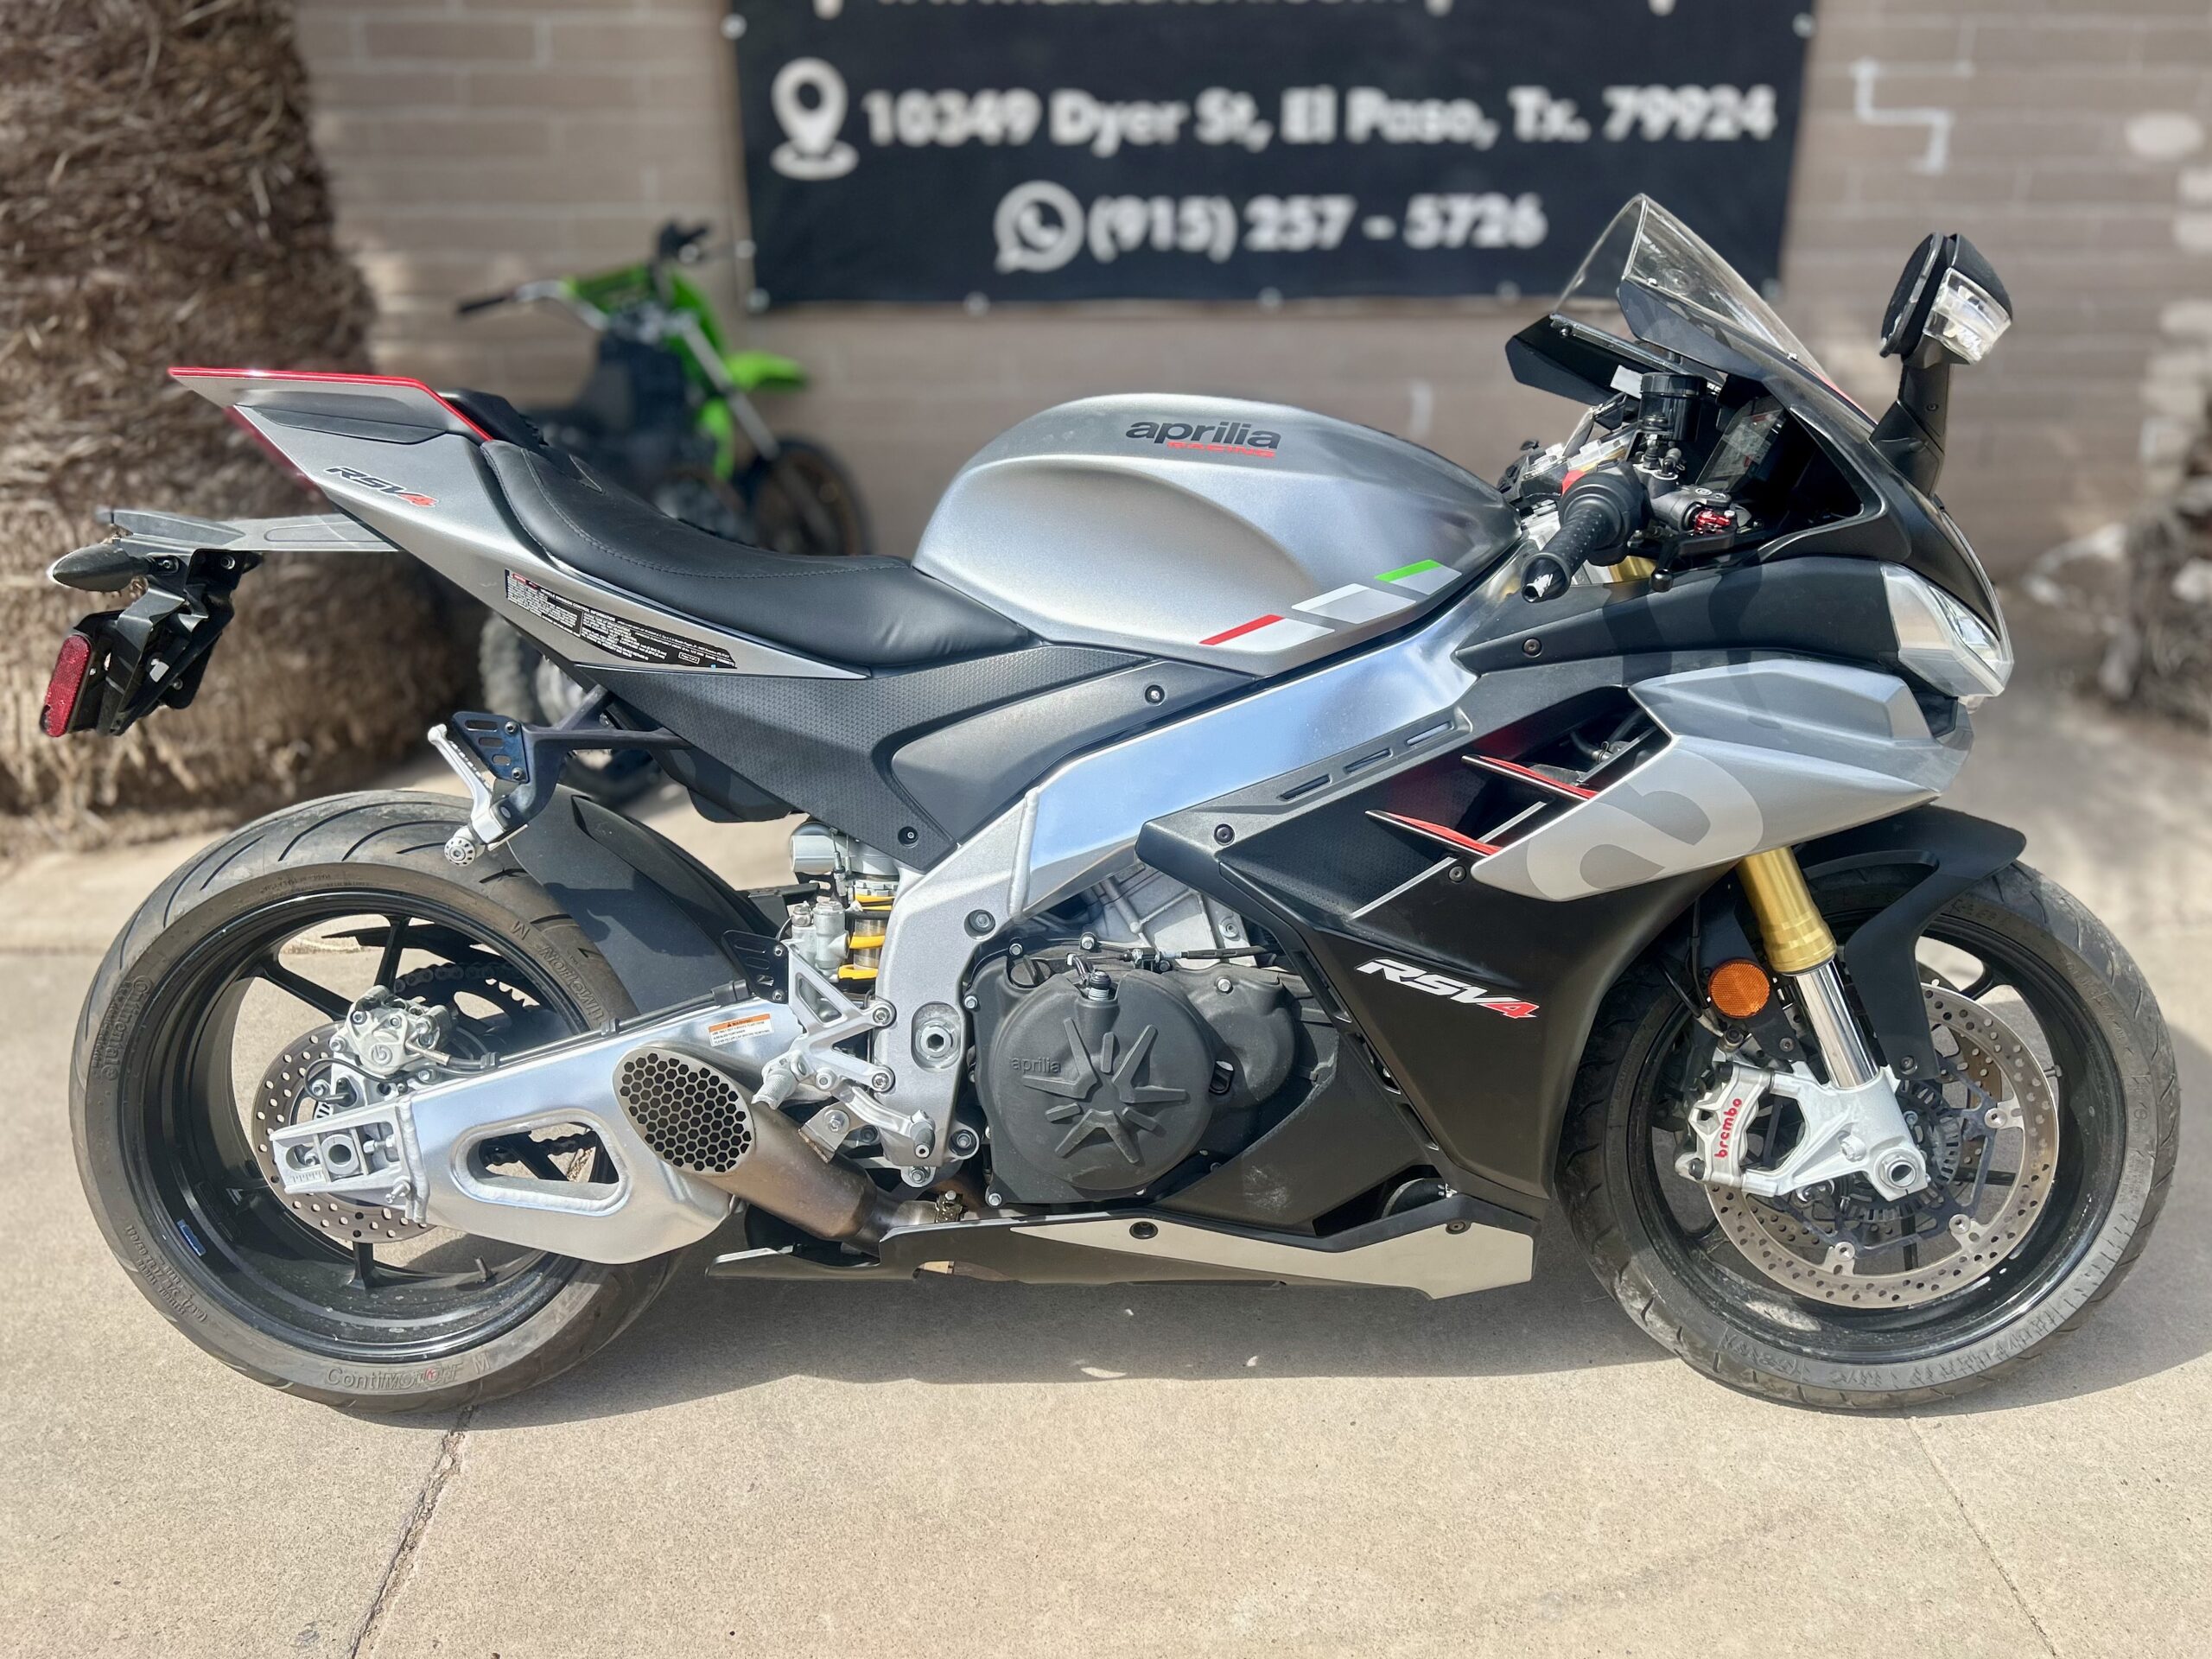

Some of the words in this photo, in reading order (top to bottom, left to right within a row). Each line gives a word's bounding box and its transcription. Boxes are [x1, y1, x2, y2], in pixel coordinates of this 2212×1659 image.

[864, 89, 1040, 146] 10349
[1049, 89, 1190, 157] Dyer
[1194, 87, 1272, 151] St,
[1281, 86, 1337, 144] El
[1345, 87, 1500, 150] Paso,
[1508, 86, 1590, 142] Tx.
[1603, 85, 1776, 141] 79924
[1087, 194, 1237, 262] (915)
[1244, 194, 1357, 251] 257
[1402, 192, 1548, 249] 5726
[1126, 422, 1281, 449] aprilia
[324, 466, 438, 506] RSV4
[1355, 958, 1540, 1019] RSV4
[1010, 1057, 1062, 1073] aprilia
[1714, 1098, 1742, 1158] brembo
